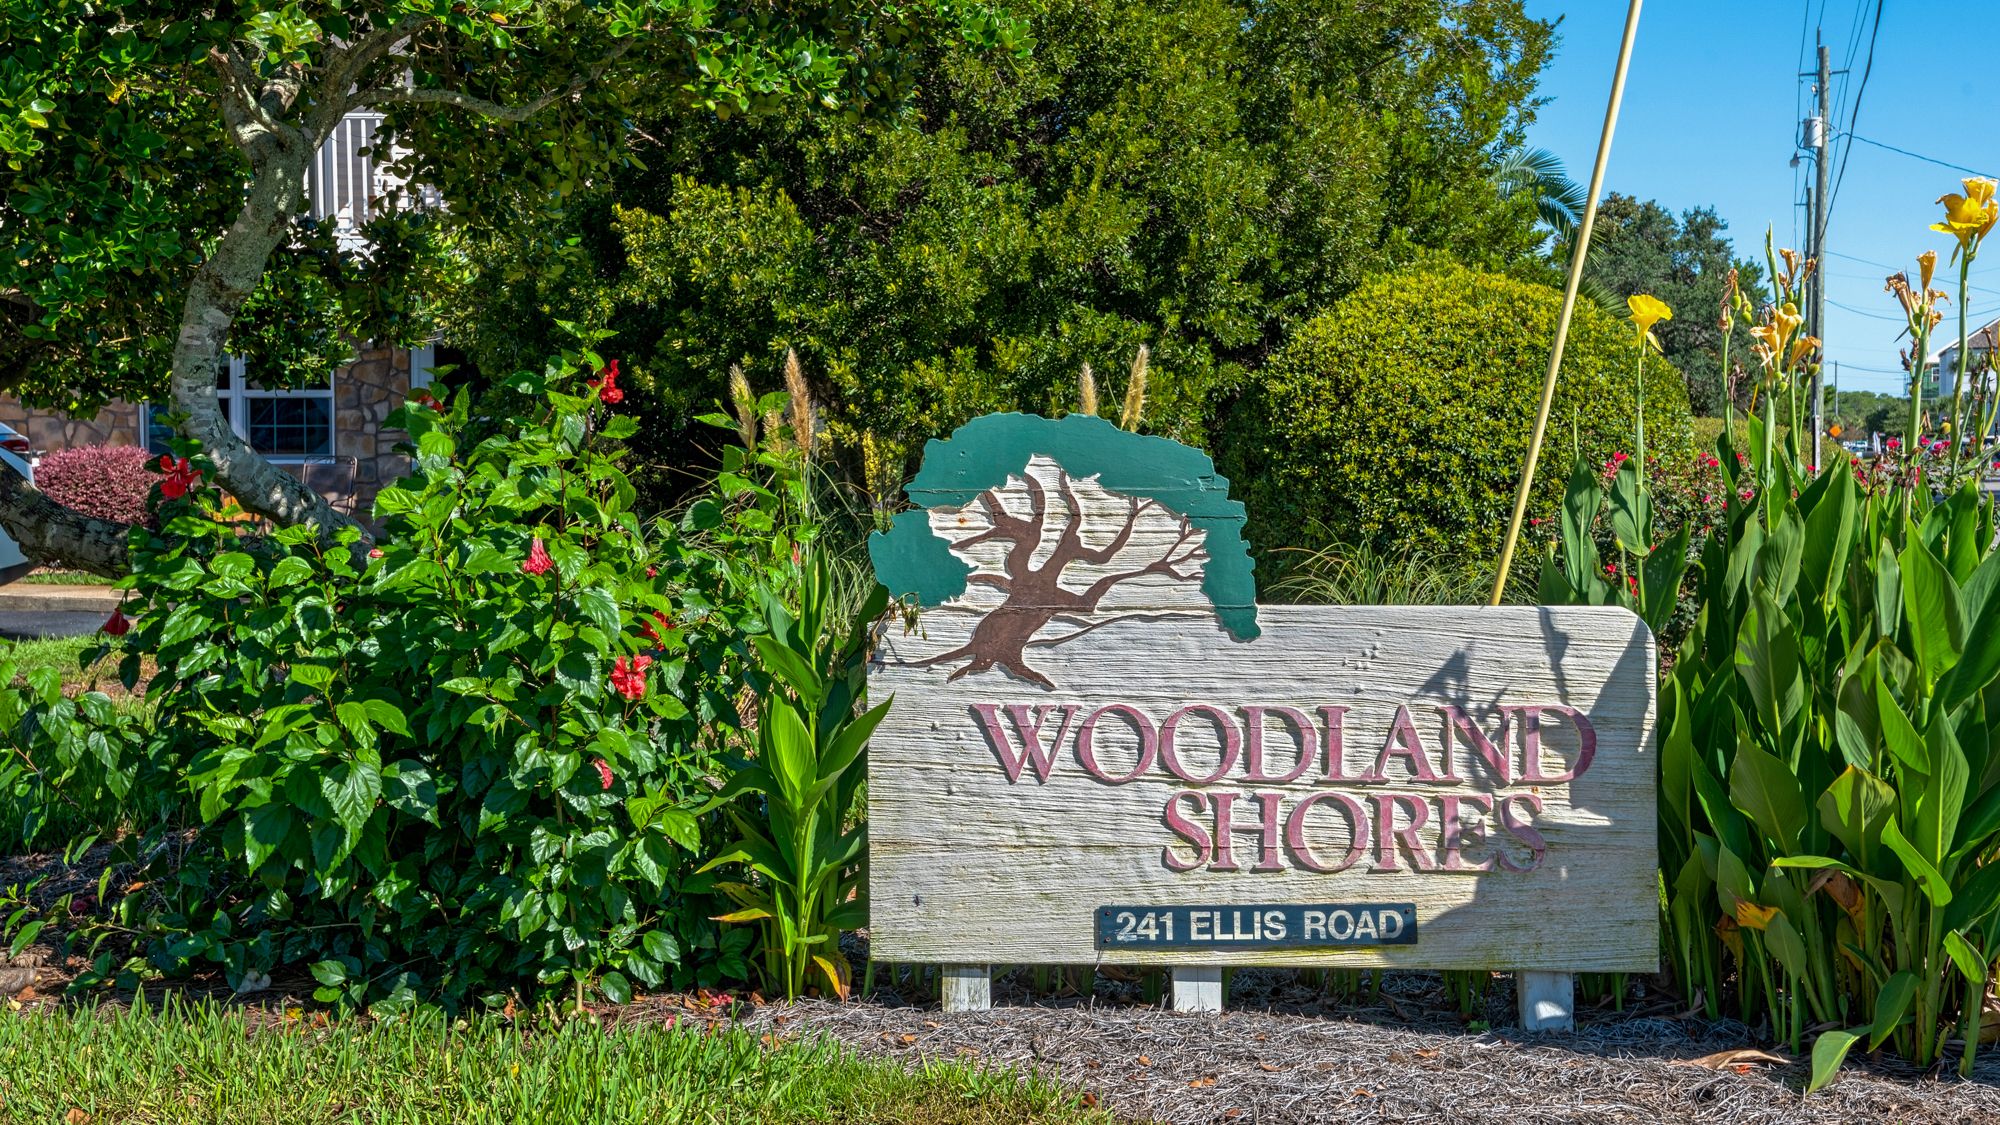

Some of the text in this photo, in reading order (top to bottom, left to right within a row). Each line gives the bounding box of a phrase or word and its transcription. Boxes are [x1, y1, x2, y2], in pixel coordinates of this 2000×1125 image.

[970, 702, 1597, 786] WOODLAND
[1164, 790, 1546, 874] SHORES
[1115, 909, 1405, 943] 241 ELLIS ROAD
